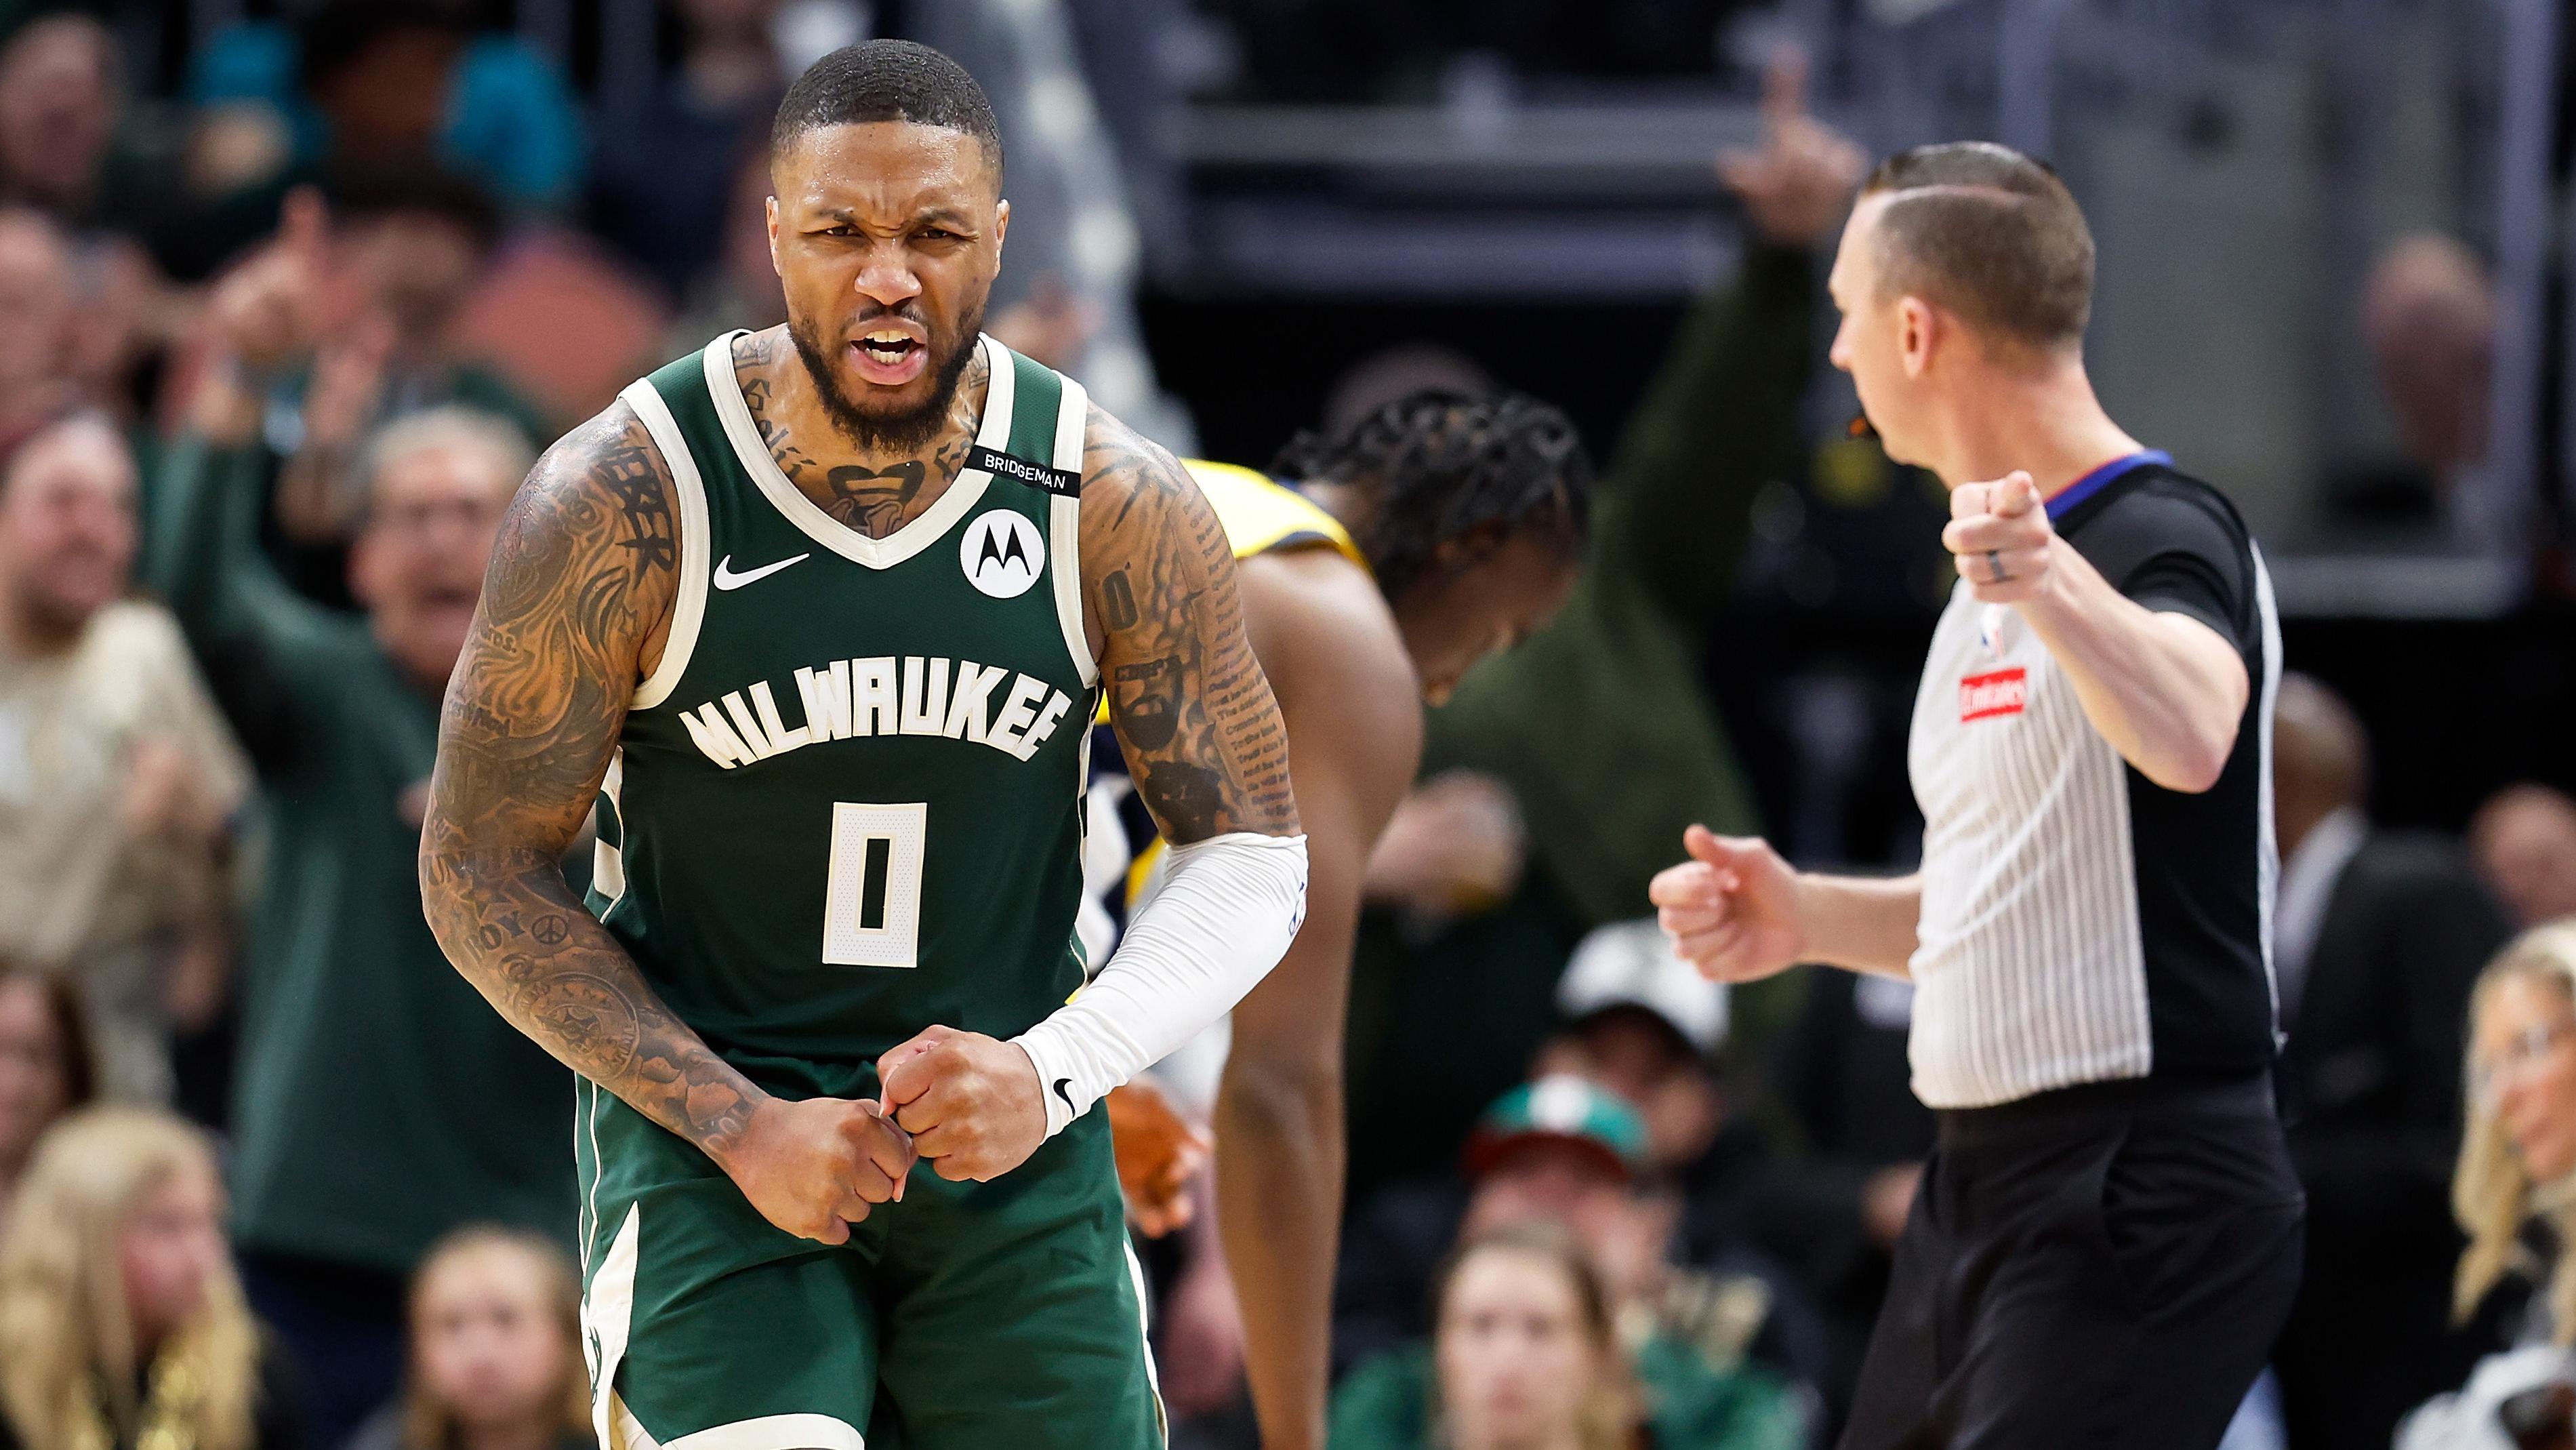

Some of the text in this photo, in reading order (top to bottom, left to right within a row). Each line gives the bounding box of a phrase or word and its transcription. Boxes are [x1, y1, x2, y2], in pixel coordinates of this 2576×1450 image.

[985, 454, 1066, 489] BRIDGEMAN
[976, 523, 1031, 578] M
[678, 656, 1072, 769] MILWAUKEE
[822, 802, 927, 967] 0
